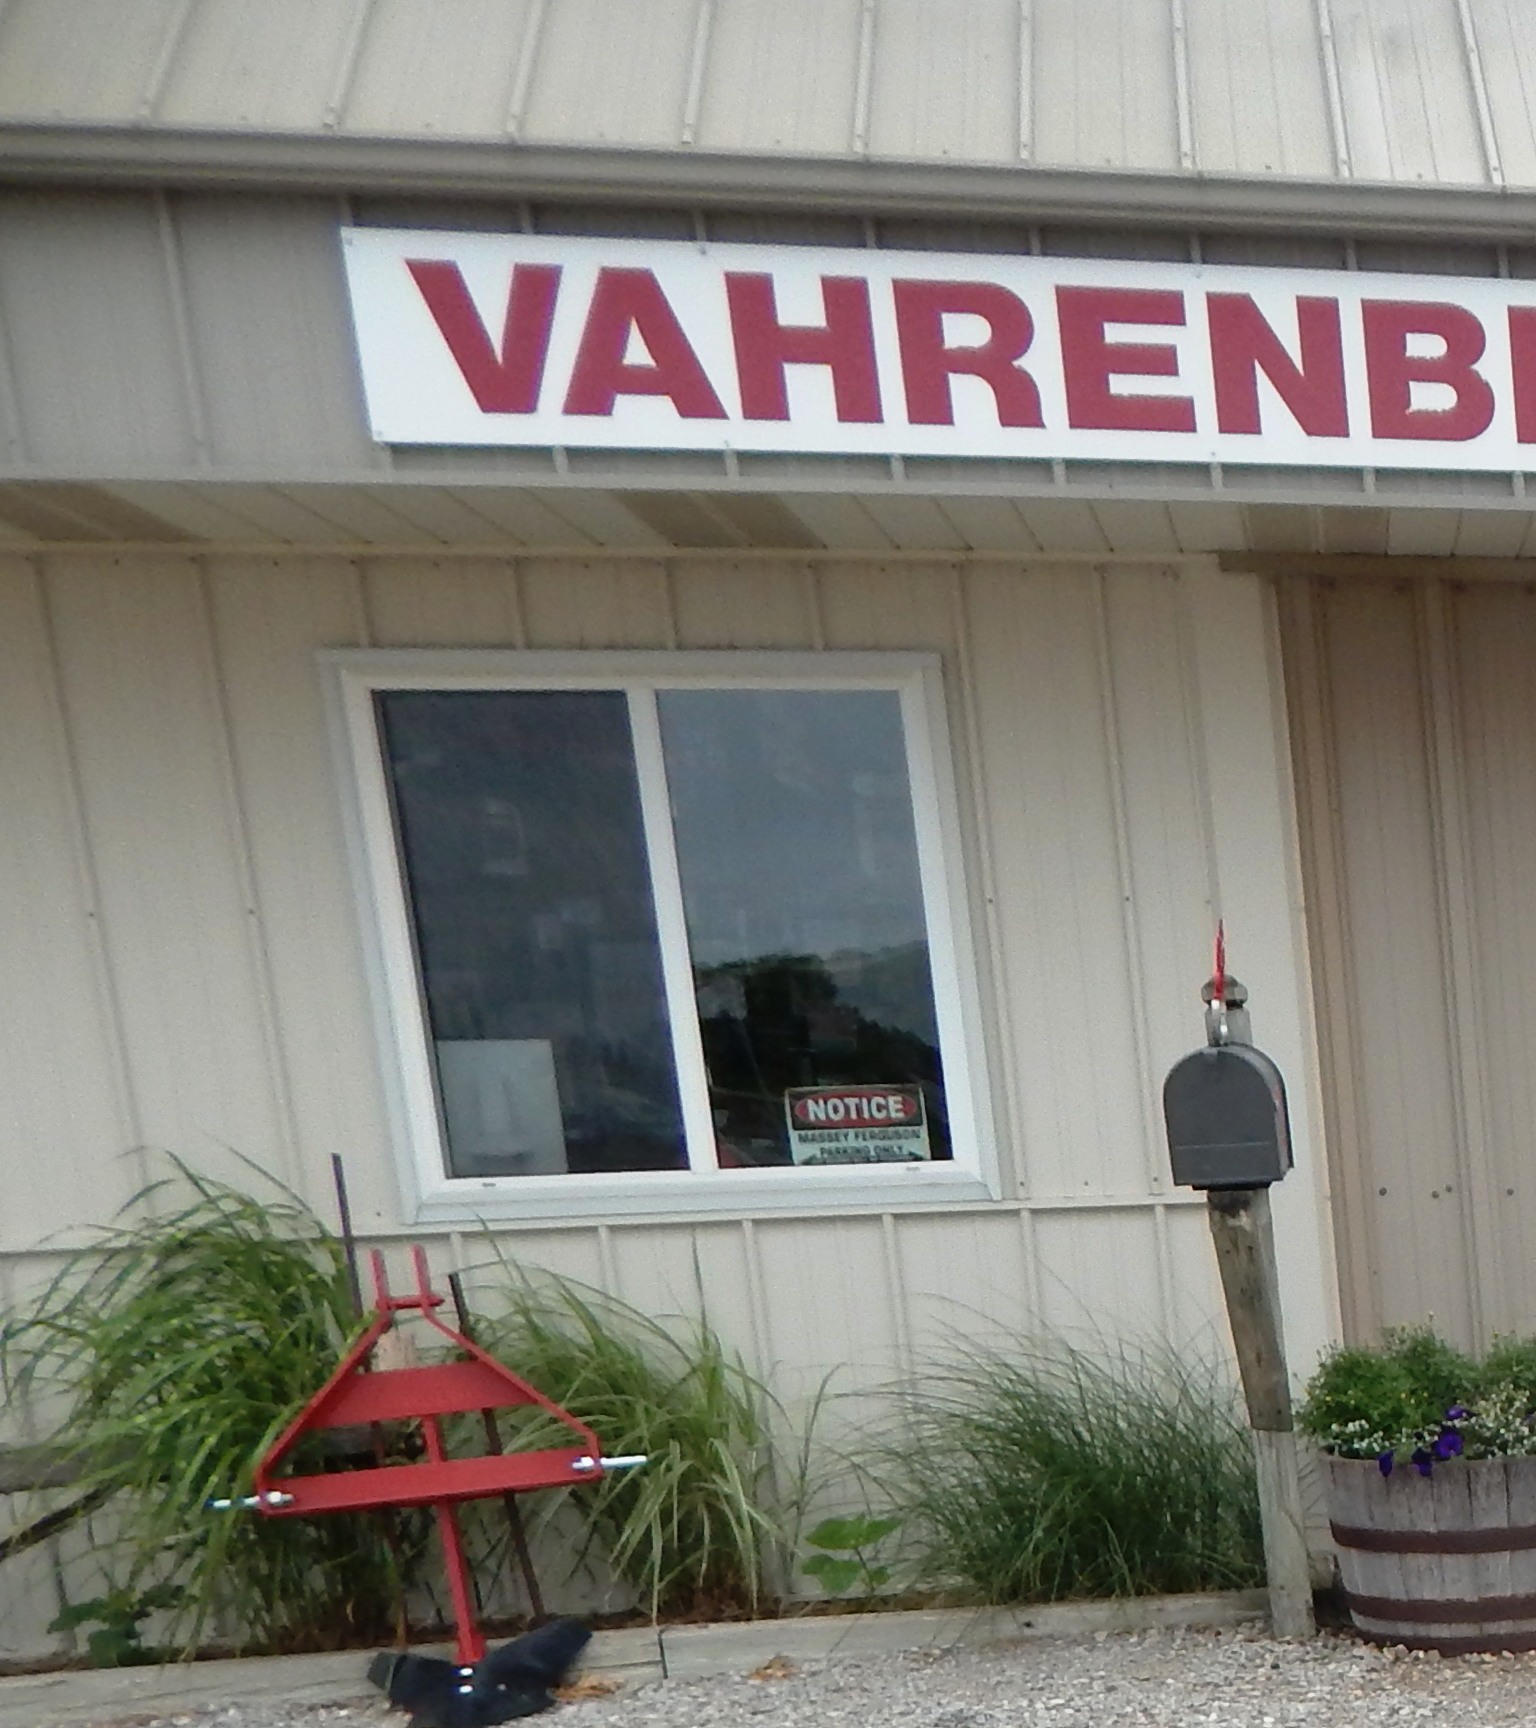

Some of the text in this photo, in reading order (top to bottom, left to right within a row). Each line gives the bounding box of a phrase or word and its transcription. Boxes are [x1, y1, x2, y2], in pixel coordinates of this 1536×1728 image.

[806, 1095, 905, 1122] NOTICE
[798, 1128, 921, 1143] MASSEY FERGUSON
